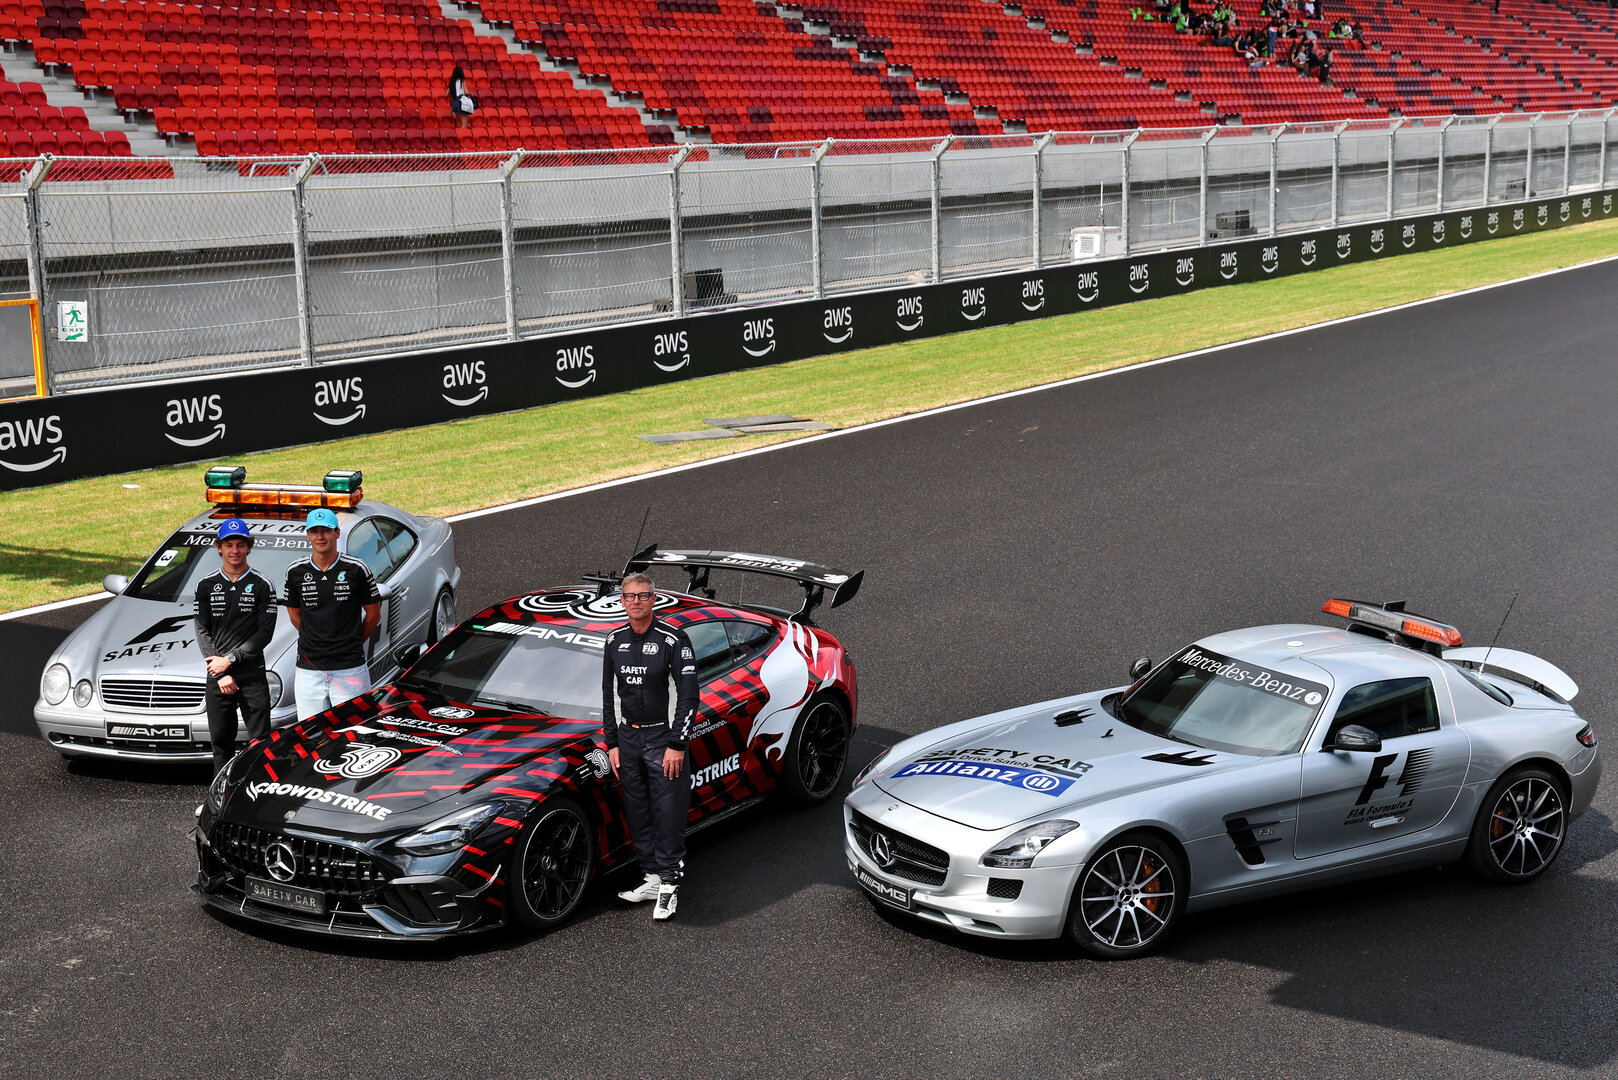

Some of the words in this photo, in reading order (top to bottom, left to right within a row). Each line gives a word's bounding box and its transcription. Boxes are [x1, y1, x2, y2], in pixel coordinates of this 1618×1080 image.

[1560, 201, 1570, 212] aws
[1582, 198, 1591, 208] aws
[1603, 194, 1612, 205] aws
[1488, 212, 1499, 223] aws
[1513, 208, 1524, 220] aws
[1537, 205, 1548, 216] aws
[1433, 220, 1445, 233] aws
[1461, 215, 1472, 227] aws
[1370, 228, 1384, 242] aws
[1402, 224, 1415, 237] aws
[1301, 239, 1316, 254] aws
[1337, 233, 1351, 247] aws
[1220, 251, 1237, 267] aws
[1262, 246, 1278, 261] aws
[1129, 263, 1149, 280] aws
[1176, 257, 1194, 273] aws
[1022, 279, 1044, 297] aws
[1078, 271, 1098, 289] aws
[897, 295, 923, 316] aws
[961, 287, 985, 306] aws
[824, 306, 852, 328] aws
[743, 317, 774, 341] aws
[654, 330, 688, 355] aws
[556, 345, 594, 371] aws
[443, 360, 486, 388] aws
[314, 376, 364, 406] aws
[166, 394, 223, 426] aws
[0, 415, 62, 450] aws
[195, 522, 274, 533] SATY
[277, 523, 307, 533] CA
[102, 639, 195, 663] SAFETY
[620, 665, 648, 675] SAFETY
[1176, 647, 1307, 701] Mercedes-Benz
[626, 676, 643, 685] CAR
[382, 715, 438, 727] SAFETY
[437, 724, 468, 735] CAR
[692, 719, 708, 732] ormula
[313, 742, 402, 779] 30
[922, 747, 1030, 759] SAFETY
[1032, 754, 1094, 773] CAR
[959, 754, 991, 762] Drive
[993, 757, 1034, 768] Safely
[902, 761, 1020, 782] Allianz
[1354, 745, 1436, 807] F1
[255, 782, 393, 821] CROWDSTRIKE
[1347, 807, 1366, 819] FIA
[1367, 800, 1407, 816] Formula
[1406, 798, 1414, 807] 1
[253, 884, 292, 902] SAFETY
[295, 894, 317, 907] CAR
